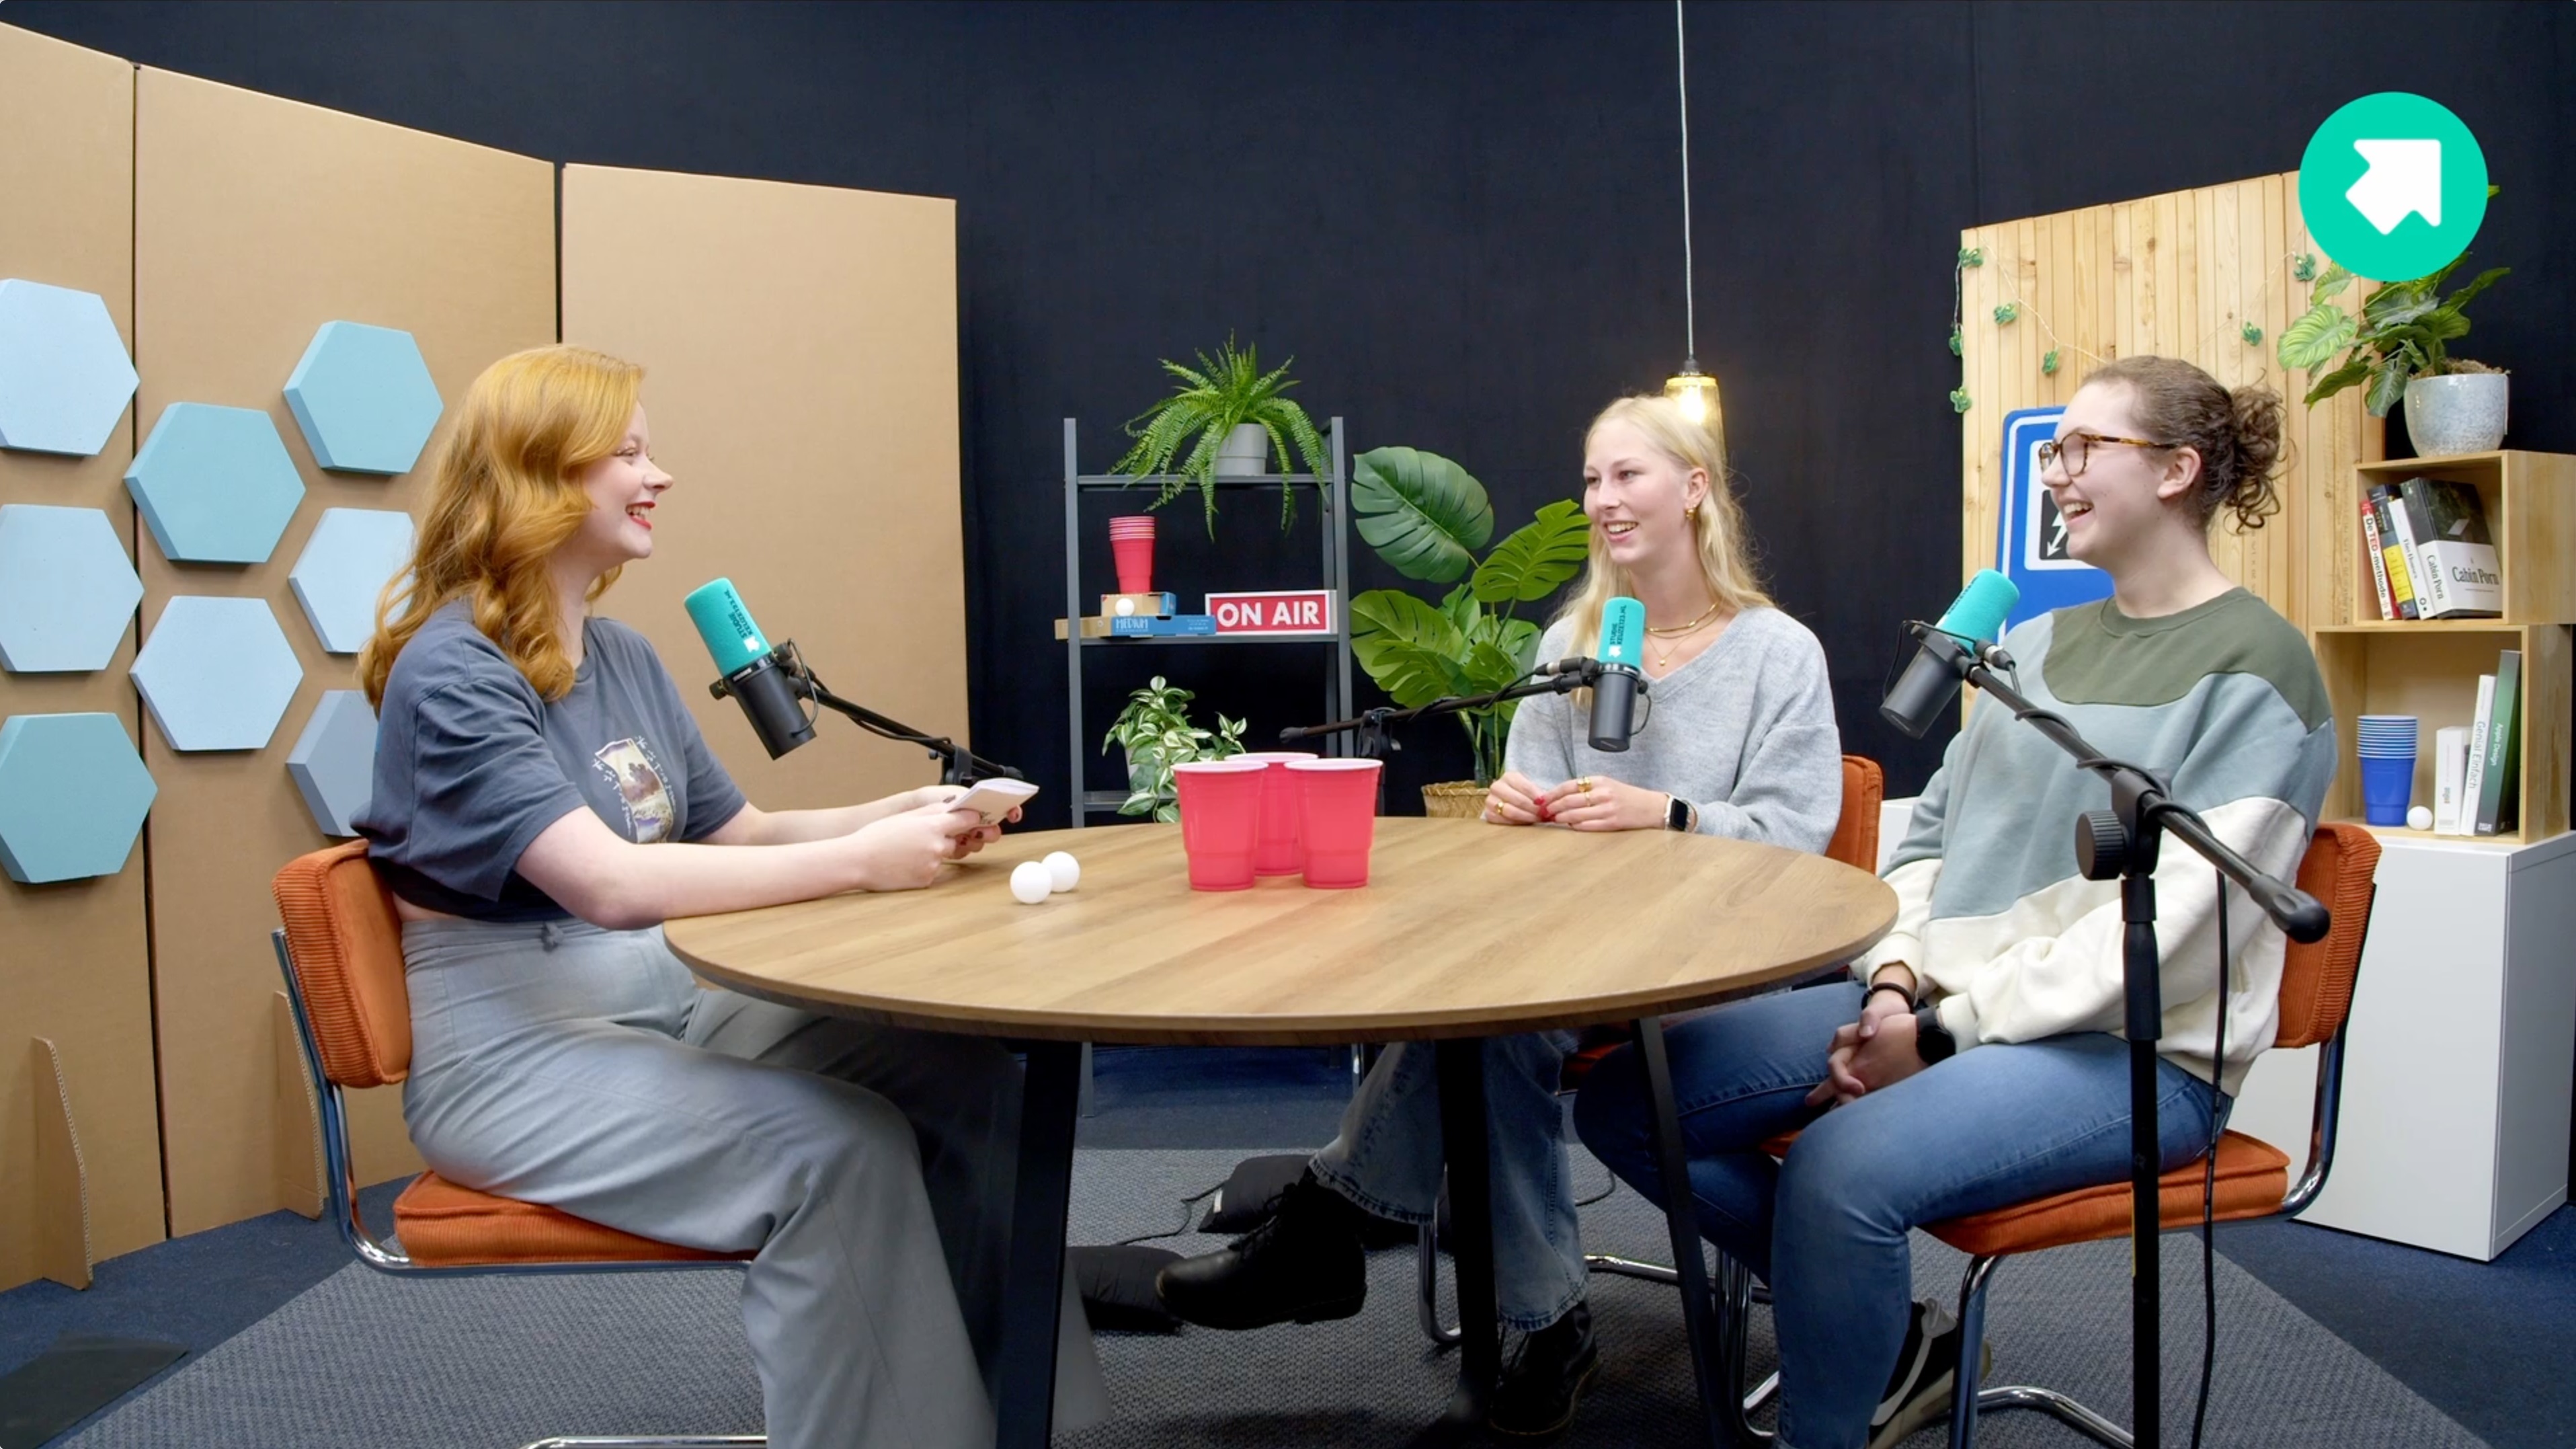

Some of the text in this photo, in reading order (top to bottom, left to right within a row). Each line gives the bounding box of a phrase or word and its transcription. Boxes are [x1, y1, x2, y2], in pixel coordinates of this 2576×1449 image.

[2366, 516, 2374, 532] De
[2426, 554, 2444, 600] Cabin Porn
[2451, 565, 2500, 586] Cabin Porn
[727, 612, 748, 639] STUDIE
[1217, 602, 1262, 627] ON
[1271, 600, 1321, 626] AIR
[2472, 720, 2487, 752] Genial
[2489, 722, 2504, 767] Apple Design
[2468, 753, 2483, 789] Einfach
